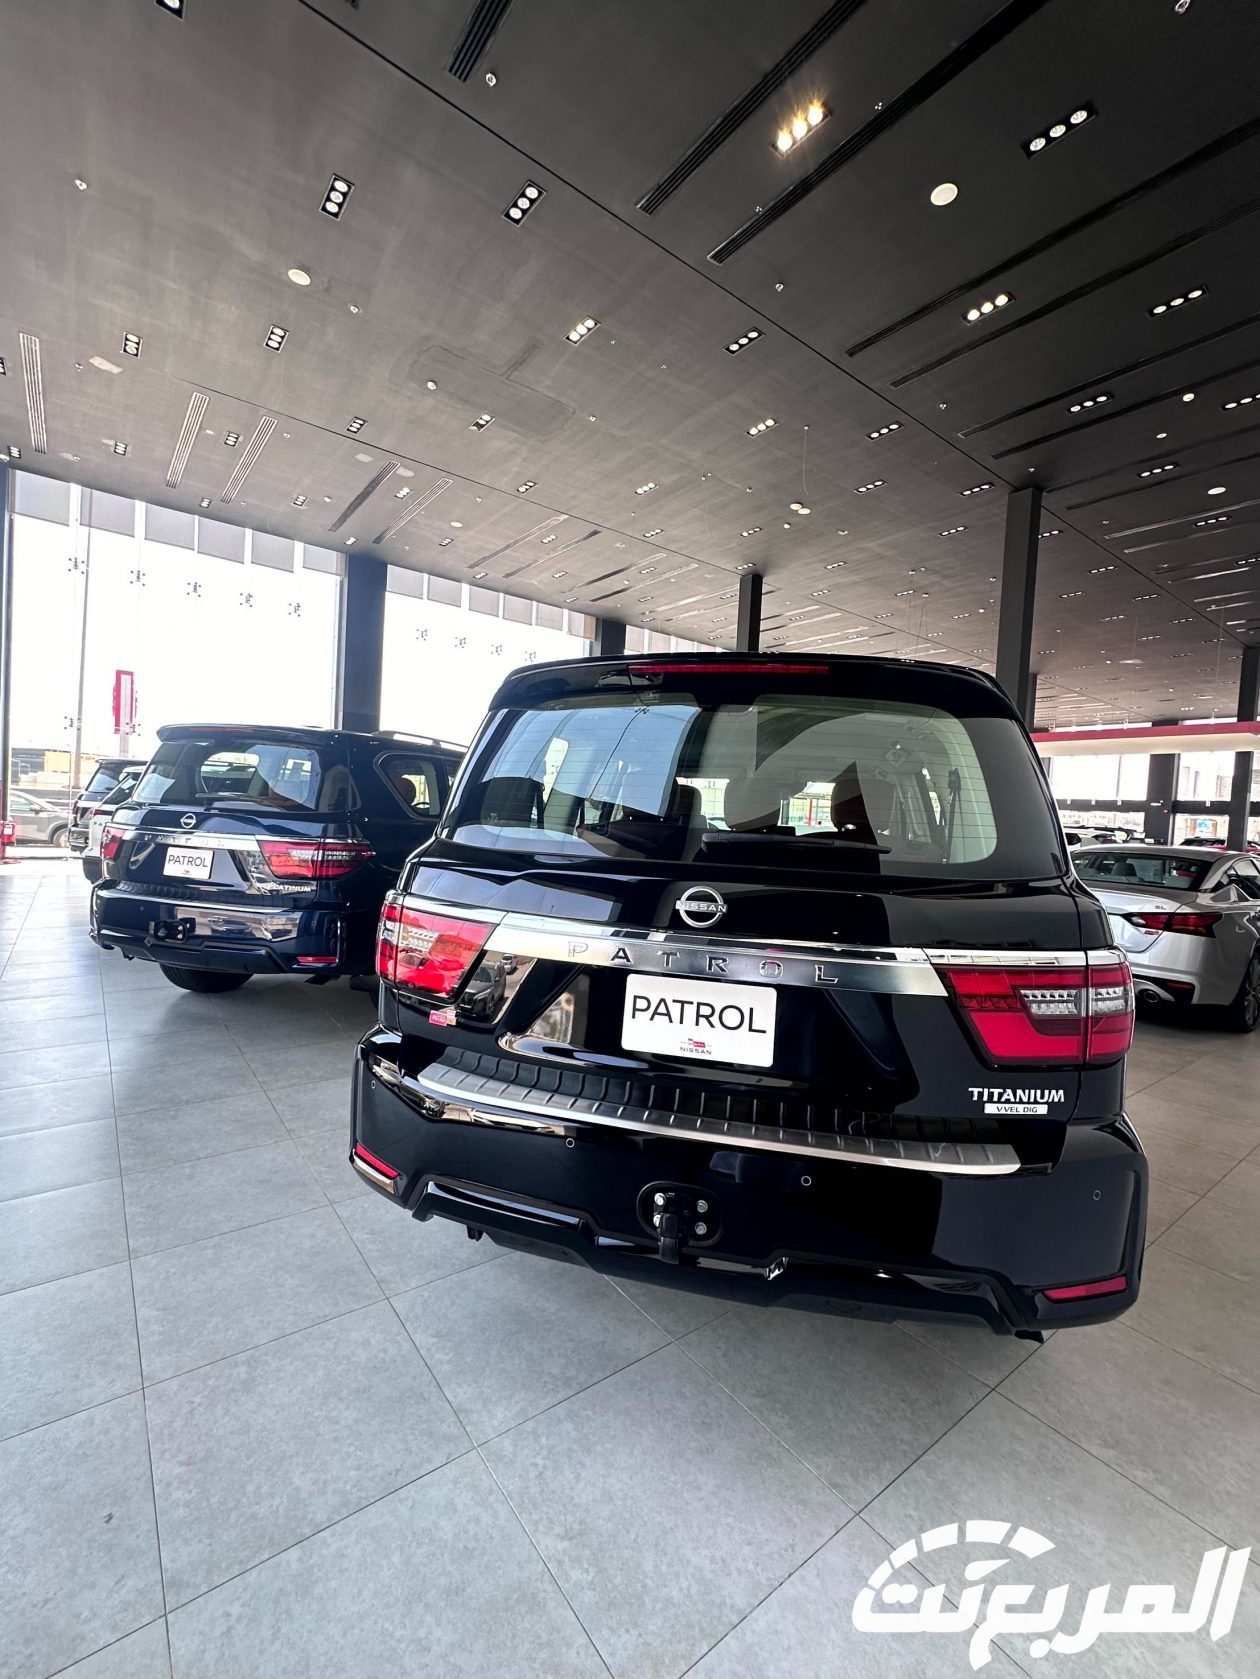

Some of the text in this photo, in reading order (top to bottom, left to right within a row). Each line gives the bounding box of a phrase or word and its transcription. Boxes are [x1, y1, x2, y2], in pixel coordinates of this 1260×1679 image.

[168, 855, 208, 867] PATROL
[271, 884, 311, 892] PLATINUM
[676, 901, 727, 913] NISSAN
[568, 941, 838, 984] PATROL
[631, 995, 767, 1034] PATROL
[680, 1046, 712, 1055] NISSAN
[968, 1087, 1065, 1103] TITANIUM
